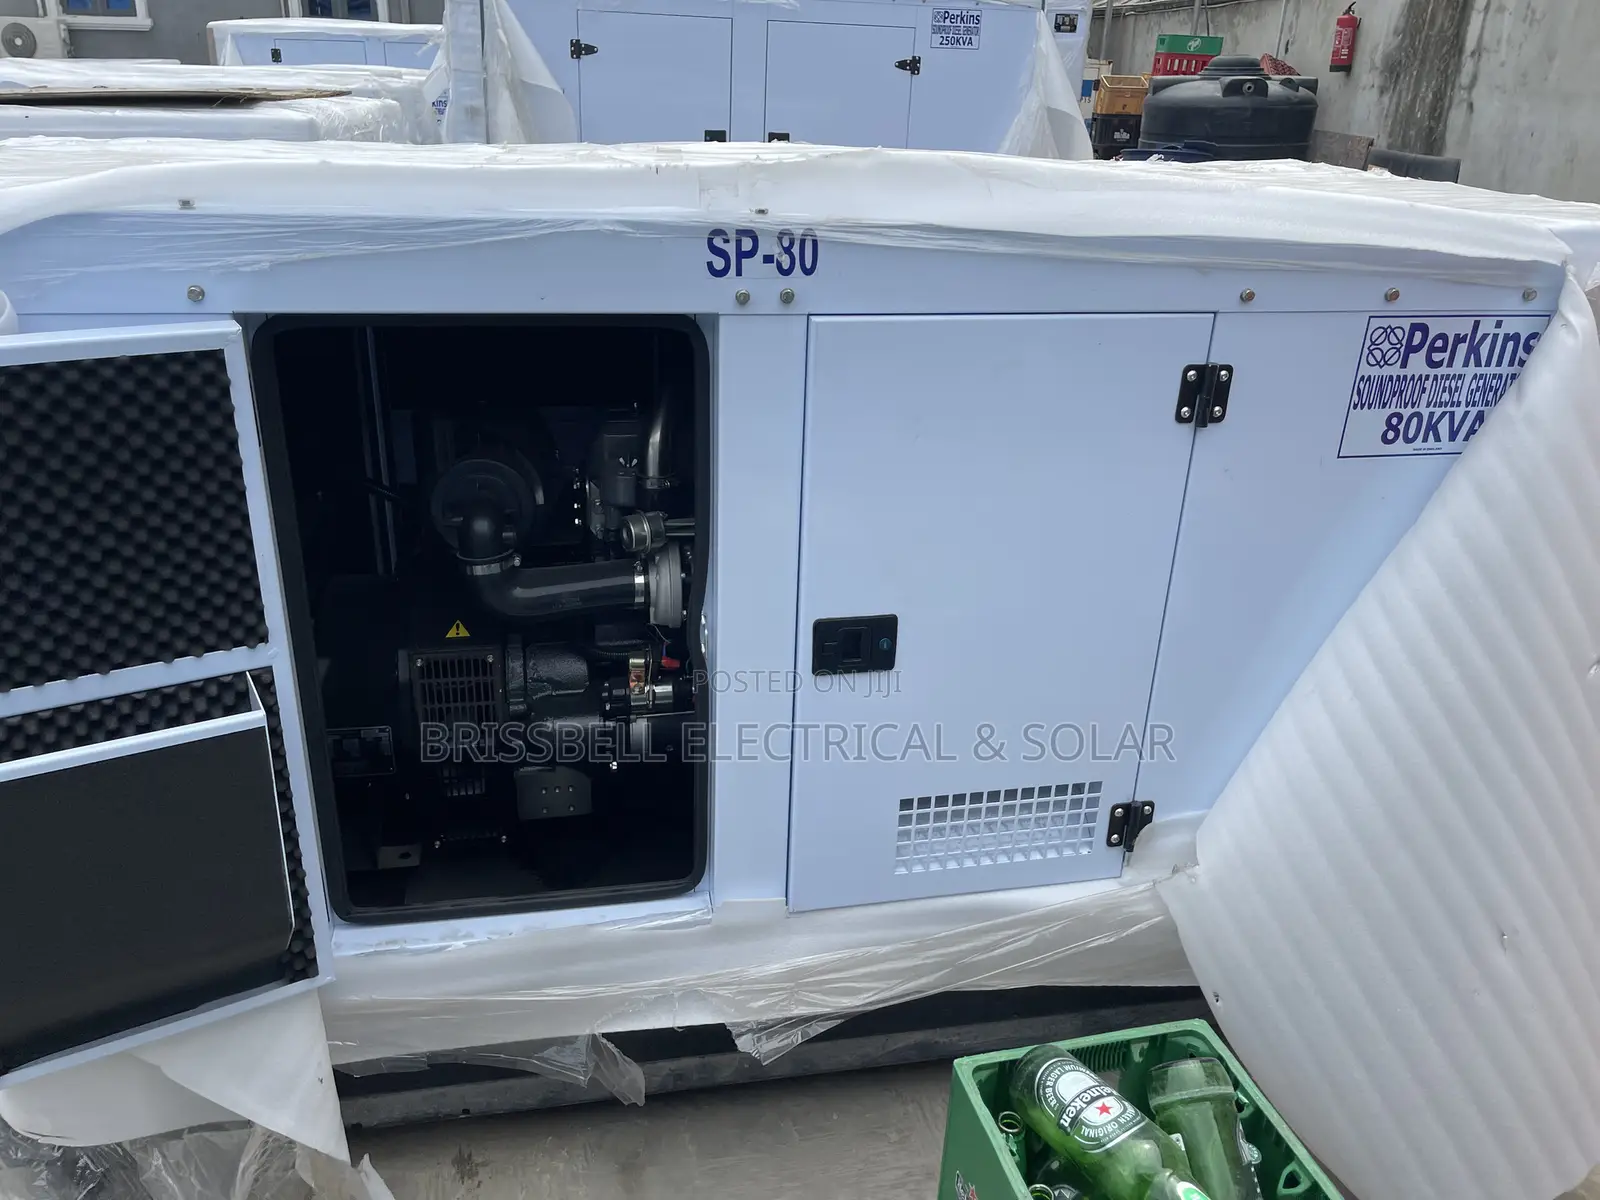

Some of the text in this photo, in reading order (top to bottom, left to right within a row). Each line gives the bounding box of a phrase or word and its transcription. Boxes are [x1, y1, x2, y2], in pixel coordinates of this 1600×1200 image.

[943, 10, 981, 25] Perkins
[939, 35, 973, 46] 250KVA
[706, 227, 819, 278] SP-80
[1399, 319, 1543, 369] Perkins
[1352, 372, 1521, 410] SOUNDPROOF DIESEL GENERAT
[1380, 410, 1486, 445] 80KVA
[1046, 1066, 1065, 1087] LAGER
[1045, 1087, 1058, 1108] BEER
[1060, 1085, 1114, 1128] eineken
[1080, 1121, 1119, 1138] ORIGINAL
